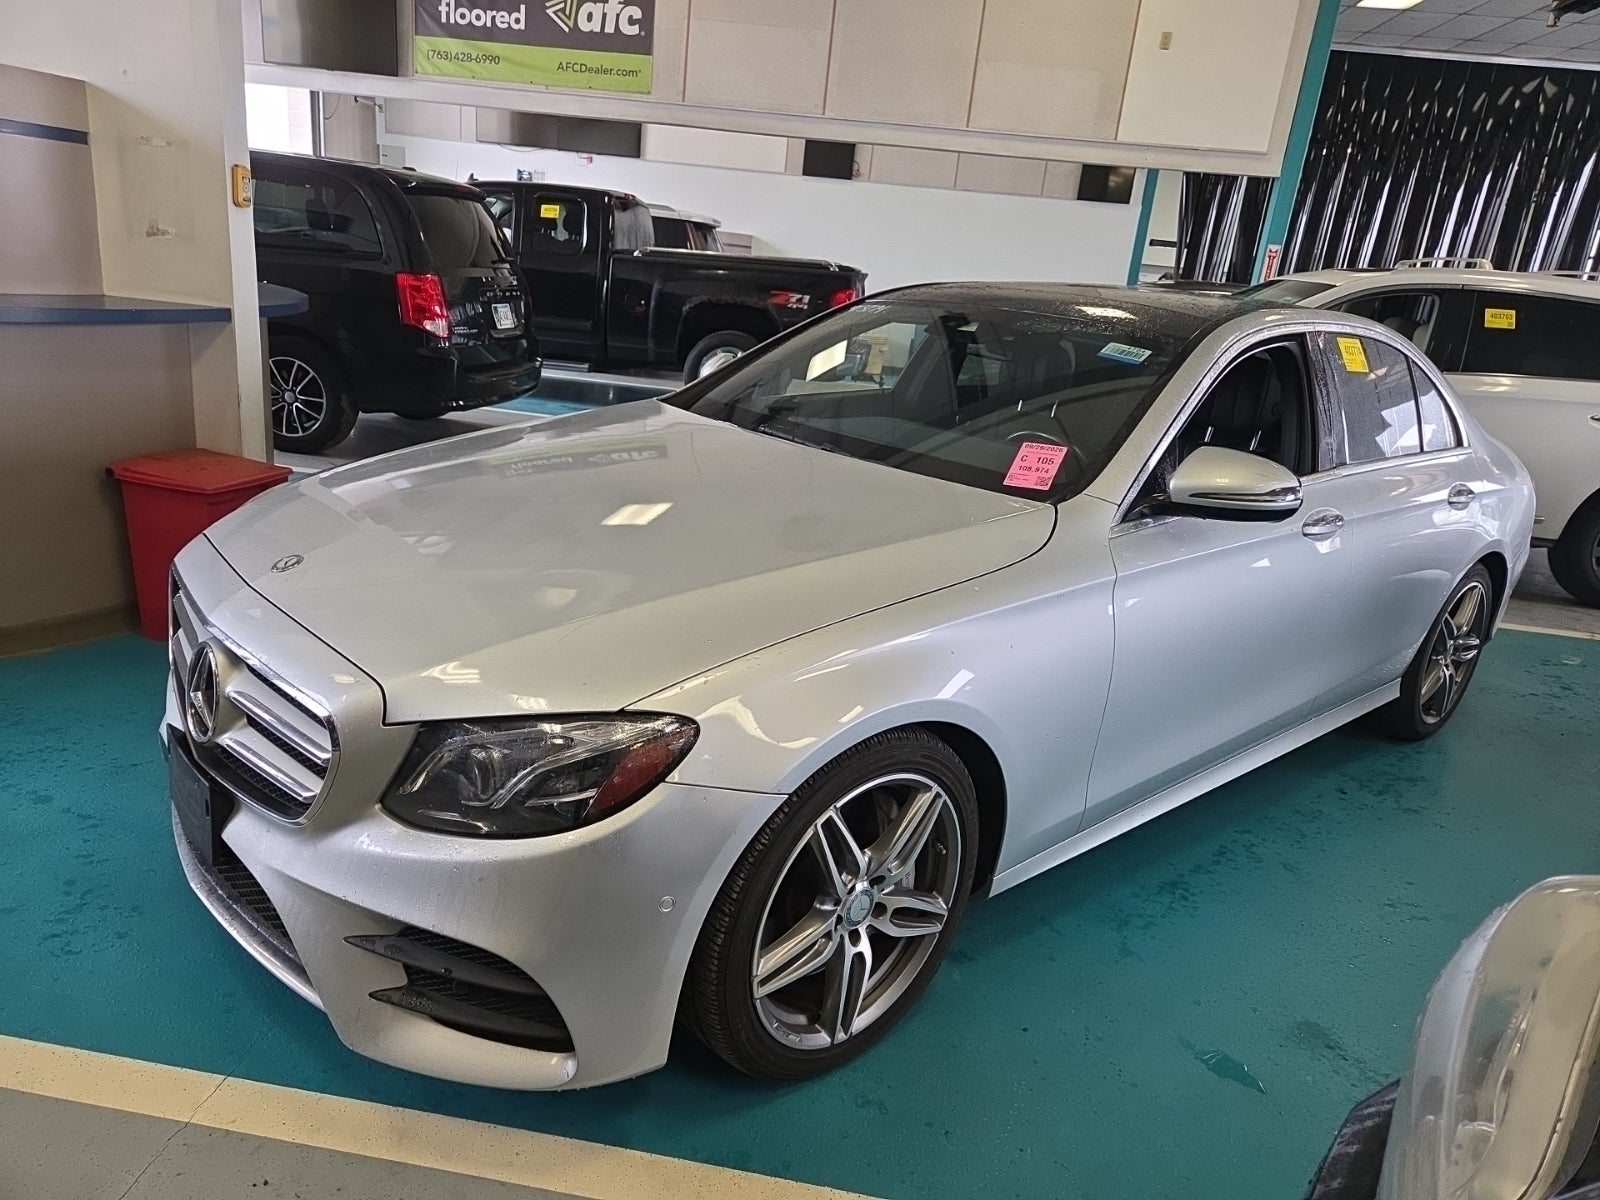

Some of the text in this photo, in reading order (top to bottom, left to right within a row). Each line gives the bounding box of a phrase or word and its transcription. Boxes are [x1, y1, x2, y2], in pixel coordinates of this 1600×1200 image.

[438, 0, 526, 30] floored
[577, 0, 642, 36] afc
[556, 61, 639, 78] AFCDealer.com
[1020, 454, 1028, 462] C
[1036, 456, 1055, 465] 105
